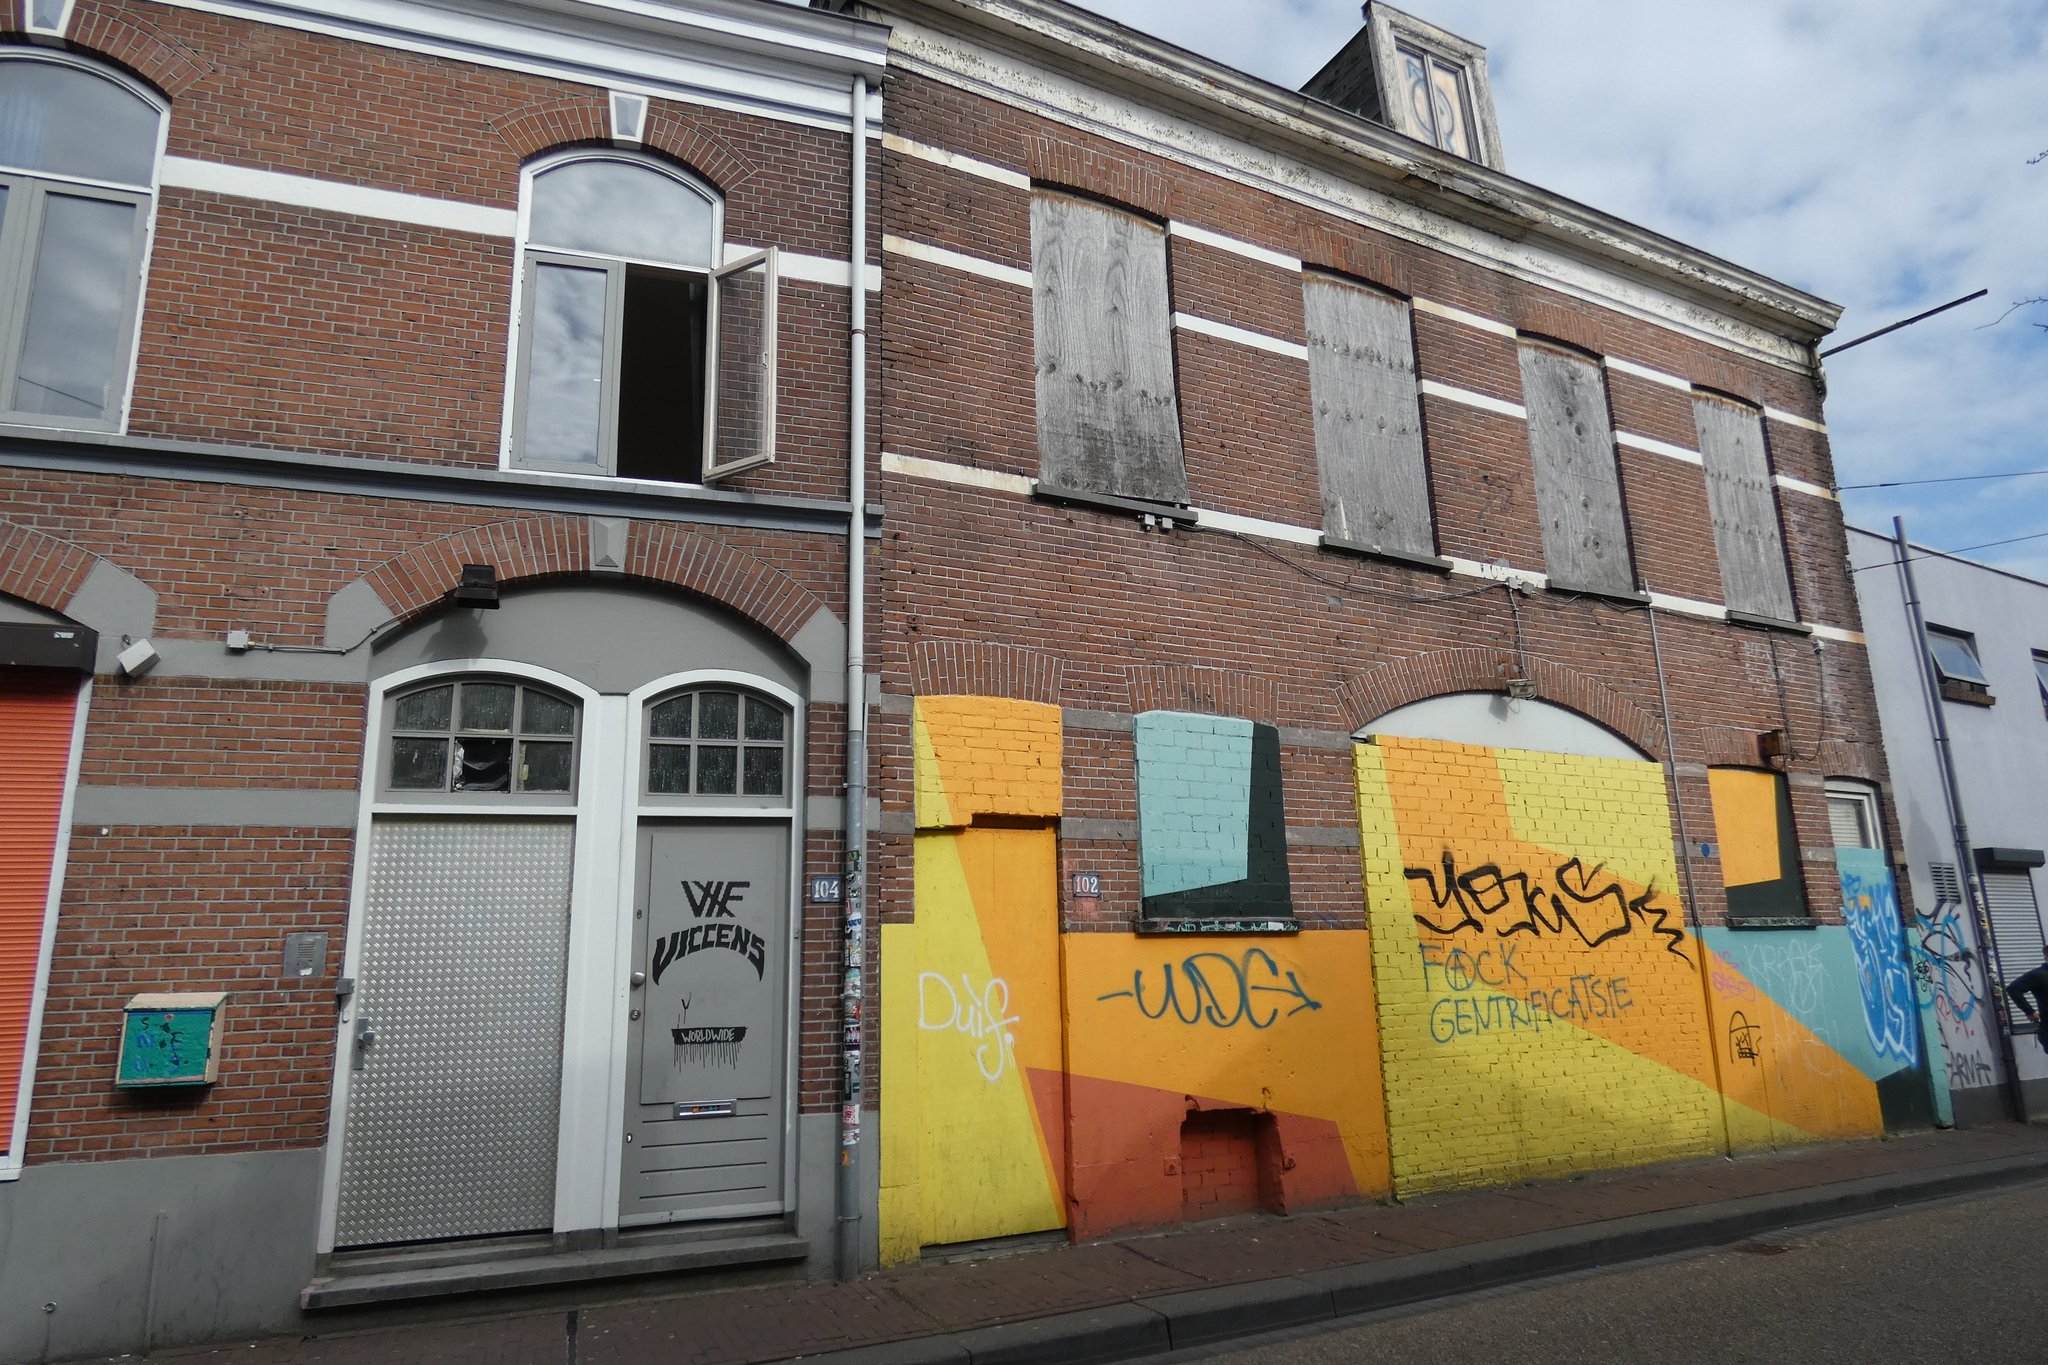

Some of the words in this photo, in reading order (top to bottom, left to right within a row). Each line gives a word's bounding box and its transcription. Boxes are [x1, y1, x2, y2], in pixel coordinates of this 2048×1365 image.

[814, 879, 839, 899] 104
[1075, 878, 1099, 895] 102
[1430, 973, 1634, 1044] GENTRIFICATSIE
[681, 1027, 735, 1043] WORLDWIDE
